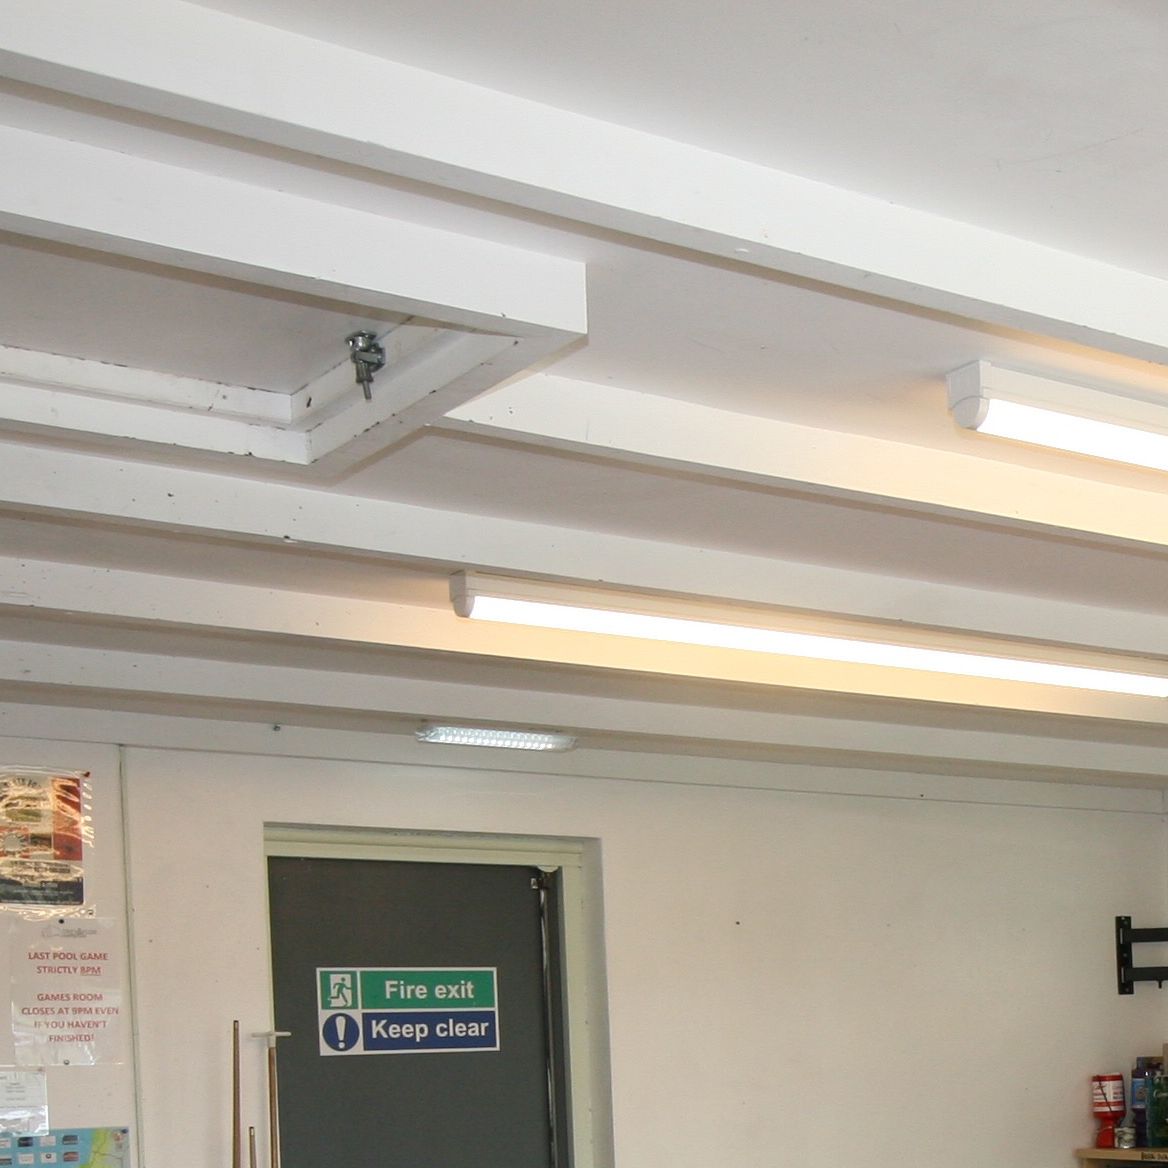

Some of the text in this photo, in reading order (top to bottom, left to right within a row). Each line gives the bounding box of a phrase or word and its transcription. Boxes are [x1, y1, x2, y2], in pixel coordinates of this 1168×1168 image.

[28, 952, 109, 960] LAST POOL GAME
[36, 966, 79, 974] STRICTLY
[384, 980, 475, 1000] Fire exit
[36, 993, 103, 1001] GAMES ROOM
[21, 1007, 119, 1015] CLOSES AT 9PM EVEN
[33, 1021, 43, 1029] IF
[45, 1020, 65, 1029] YOU
[370, 1018, 489, 1042] Keep clear
